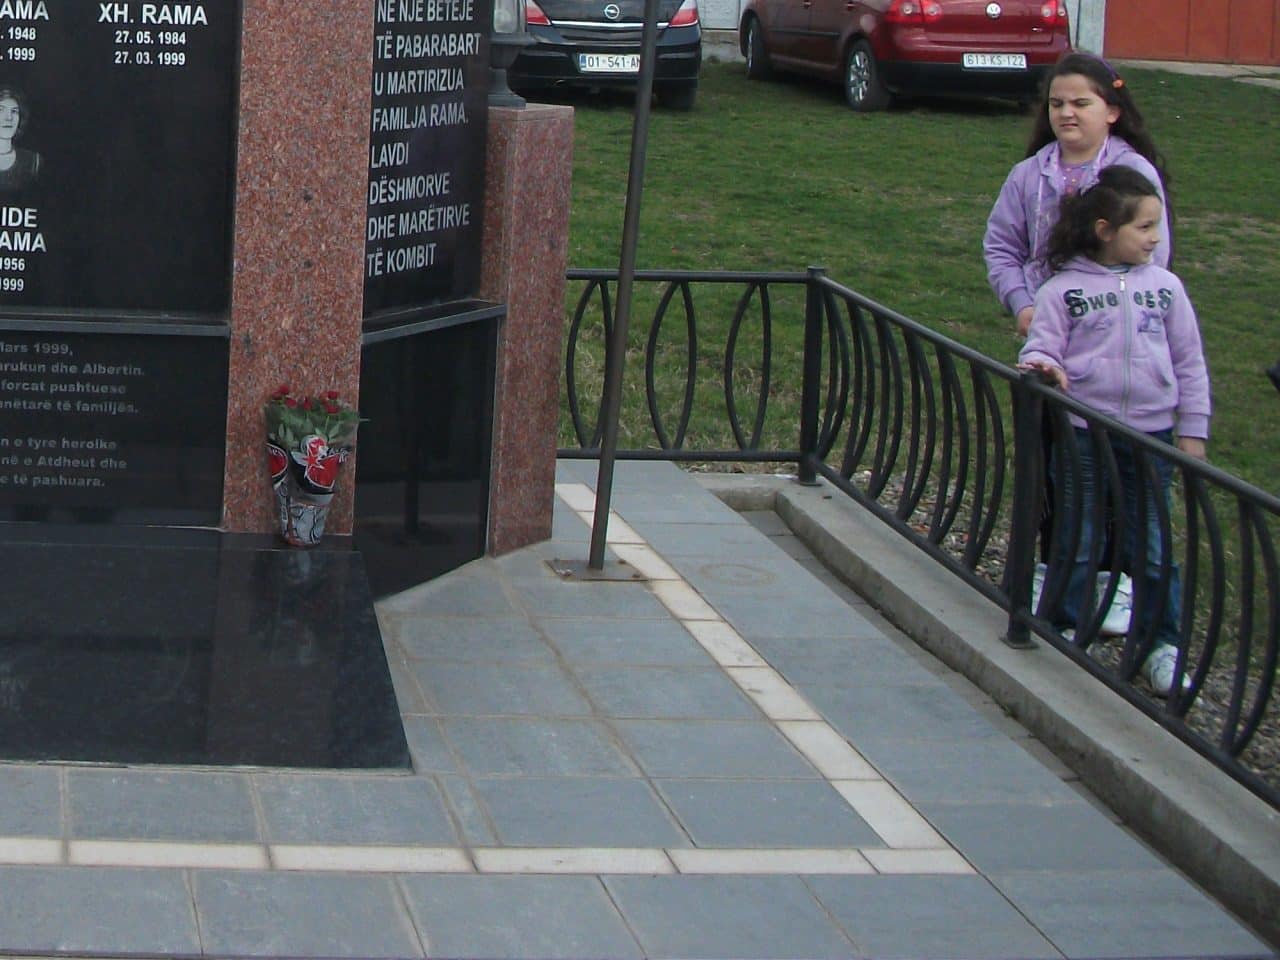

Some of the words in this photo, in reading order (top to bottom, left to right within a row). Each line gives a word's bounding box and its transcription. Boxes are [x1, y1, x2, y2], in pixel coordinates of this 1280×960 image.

[99, 3, 133, 23] XH.
[143, 4, 207, 25] RAMA
[9, 27, 35, 40] 1948
[116, 31, 132, 43] 27.
[137, 31, 153, 44] 05.
[159, 32, 185, 44] 1984
[376, 31, 392, 59] TË
[396, 33, 480, 58] PABARABART
[8, 48, 35, 60] 1999
[115, 51, 132, 63] 27.
[136, 52, 153, 64] 03.
[158, 52, 185, 65] 1999
[375, 72, 383, 95] U
[388, 69, 464, 94] MARTIRIZUA
[373, 105, 427, 132] FAMILJA
[372, 142, 408, 168] LAVDI
[370, 173, 449, 204] DËSHMORVE
[368, 215, 395, 240] DHE
[367, 252, 383, 276] TË
[387, 243, 436, 273] KOMBIT
